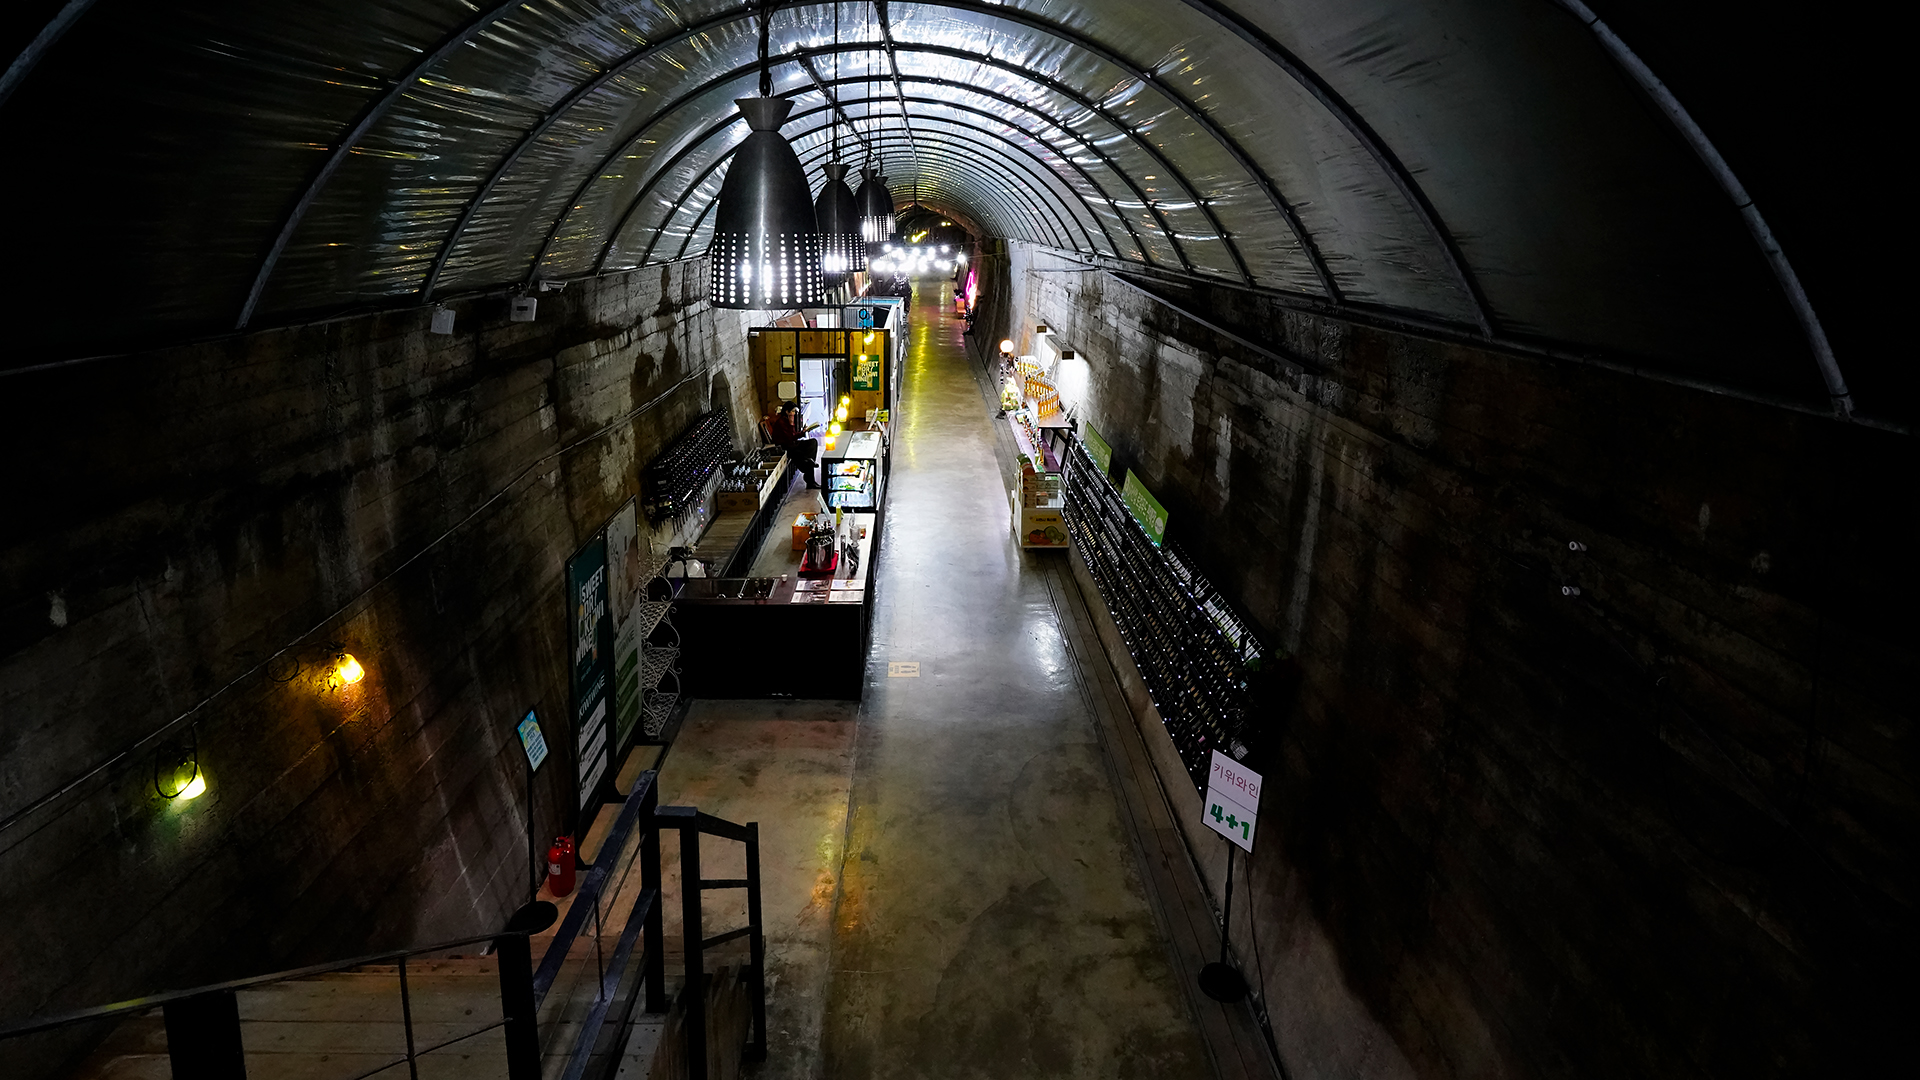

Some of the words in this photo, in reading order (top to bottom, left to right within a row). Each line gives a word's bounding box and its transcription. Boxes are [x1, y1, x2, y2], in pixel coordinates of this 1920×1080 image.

[582, 564, 604, 603] SWEET
[576, 636, 594, 667] WINE
[1214, 763, 1259, 799] 키위와인
[1210, 803, 1250, 840] 4+1
